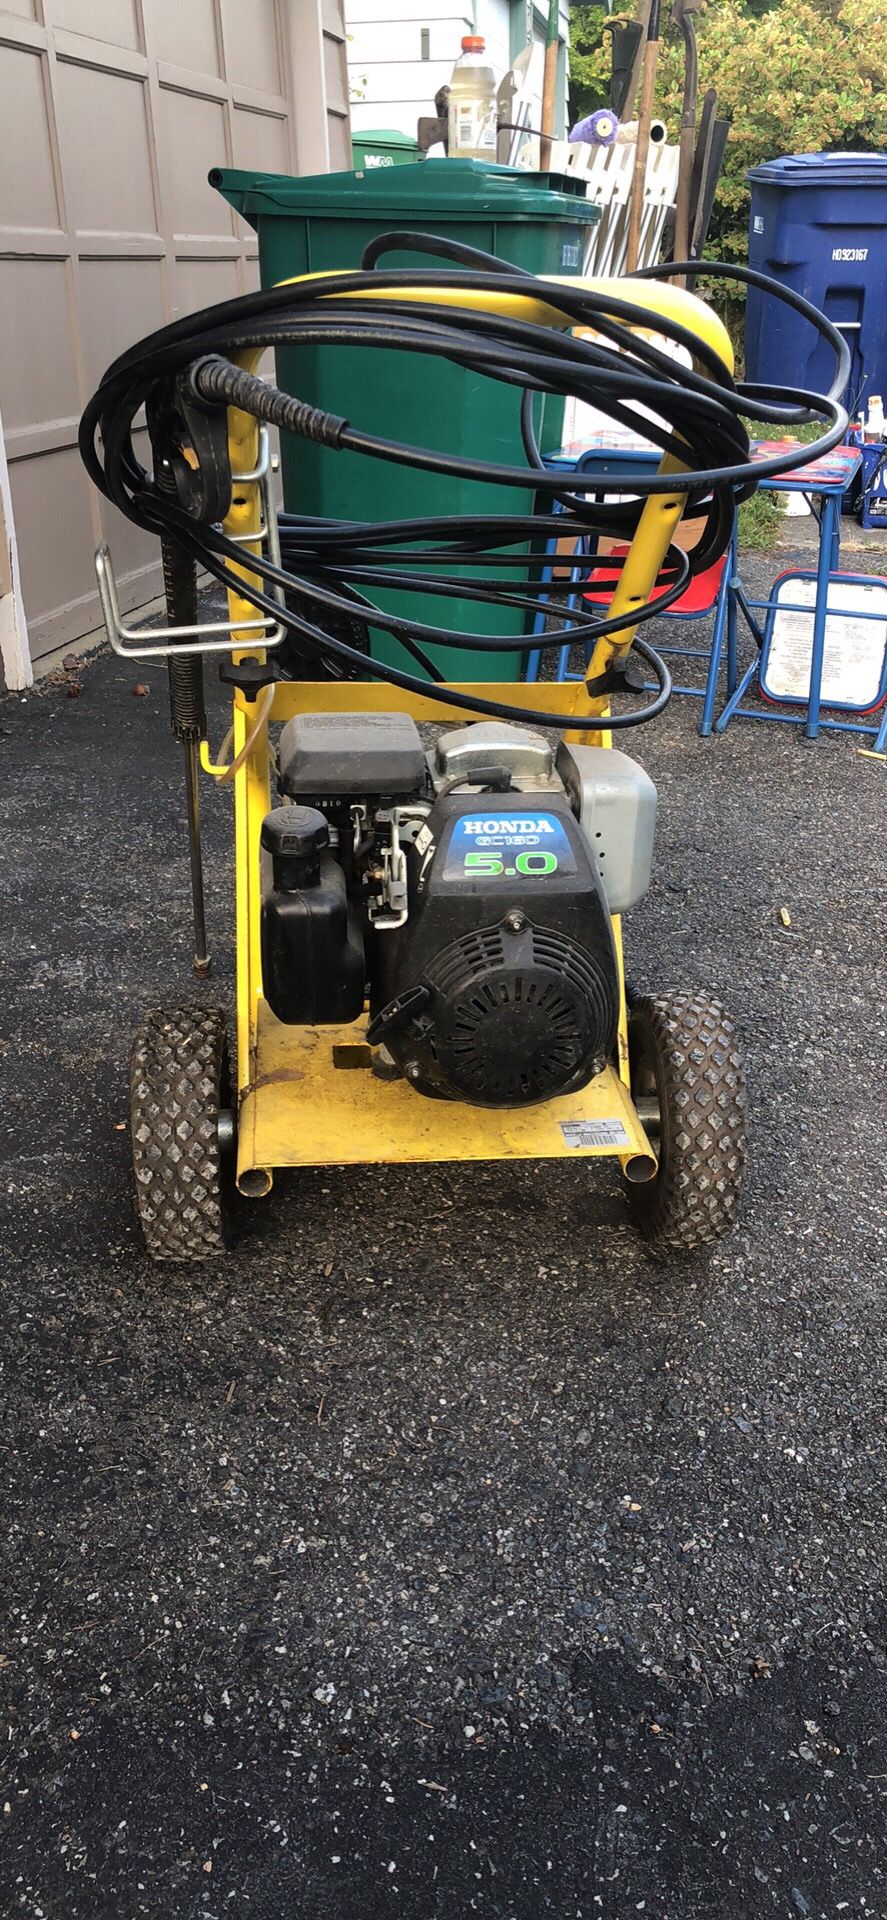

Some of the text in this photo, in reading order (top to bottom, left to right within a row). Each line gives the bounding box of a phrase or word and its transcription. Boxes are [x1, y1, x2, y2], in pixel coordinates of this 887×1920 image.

[463, 819, 555, 834] HONDA
[475, 835, 540, 846] GC160
[464, 851, 558, 876] 5.0
